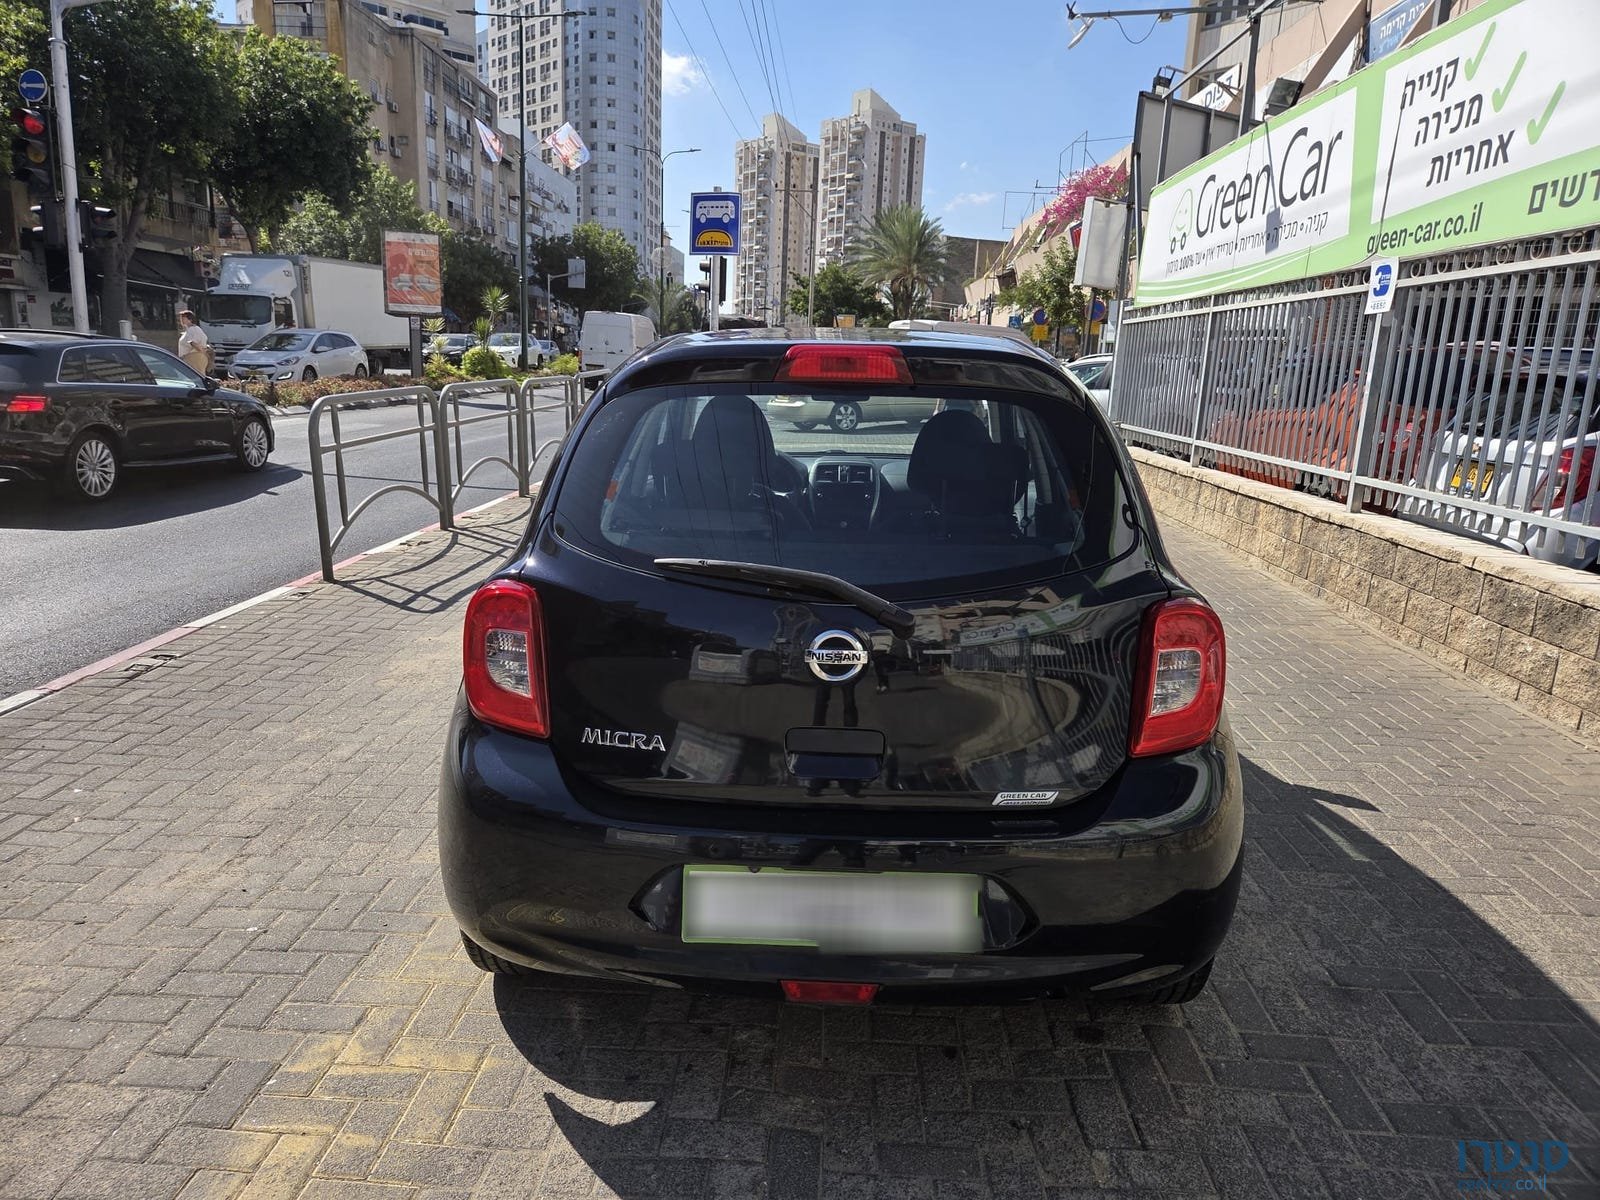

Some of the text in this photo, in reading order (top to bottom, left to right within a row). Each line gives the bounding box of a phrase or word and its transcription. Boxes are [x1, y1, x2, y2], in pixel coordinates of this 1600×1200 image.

[1380, 12, 1406, 39] קדימה
[1400, 57, 1460, 110] קנייה
[1414, 93, 1484, 147] מכירה
[1425, 130, 1516, 188] אחריות
[1270, 220, 1299, 243] מכירה
[1305, 211, 1329, 236] קניה
[1178, 254, 1194, 270] 100%
[811, 652, 862, 662] NISSAN
[580, 727, 667, 752] MICRA
